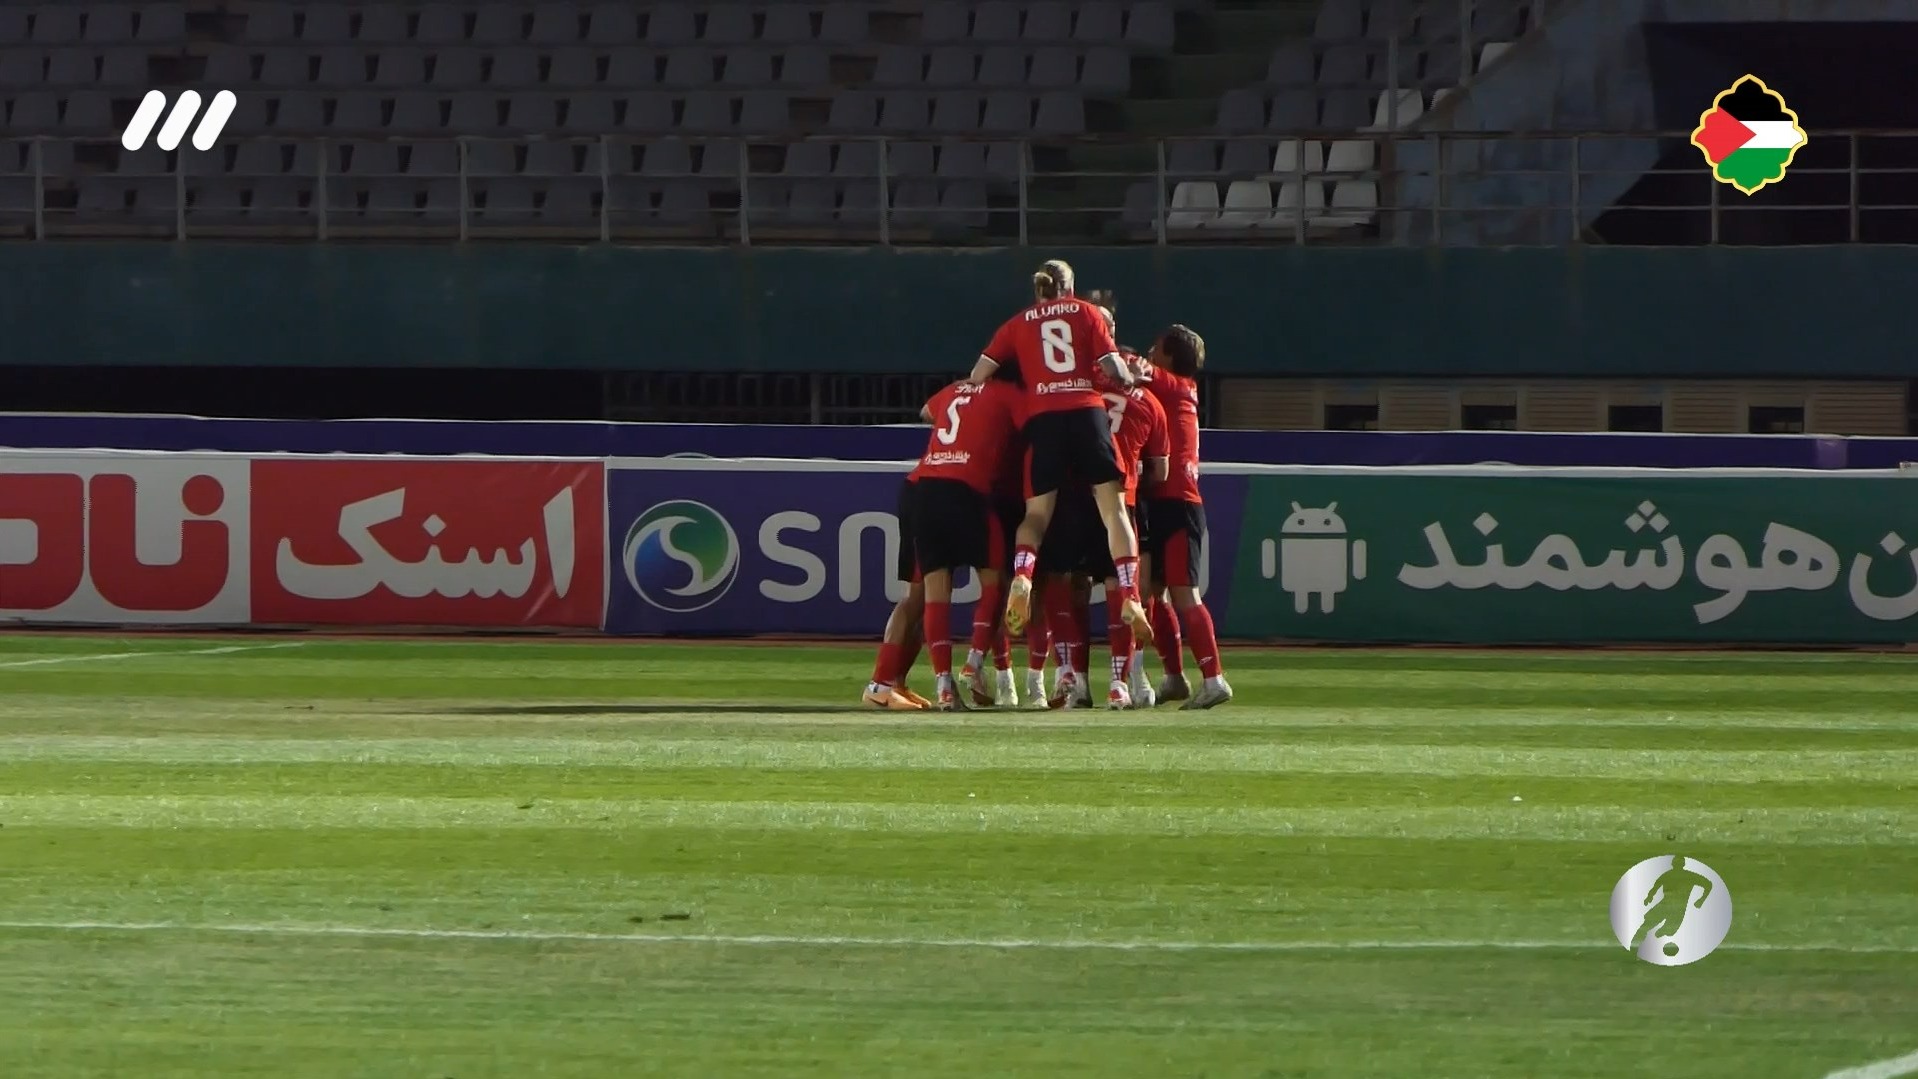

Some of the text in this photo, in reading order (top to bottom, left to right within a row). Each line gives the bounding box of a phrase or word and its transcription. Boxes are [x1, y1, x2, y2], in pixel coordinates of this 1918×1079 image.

[1041, 319, 1076, 373] 8
[937, 397, 971, 445] 5
[276, 486, 575, 599] اسنک
[1397, 500, 1840, 624] هوشمند
